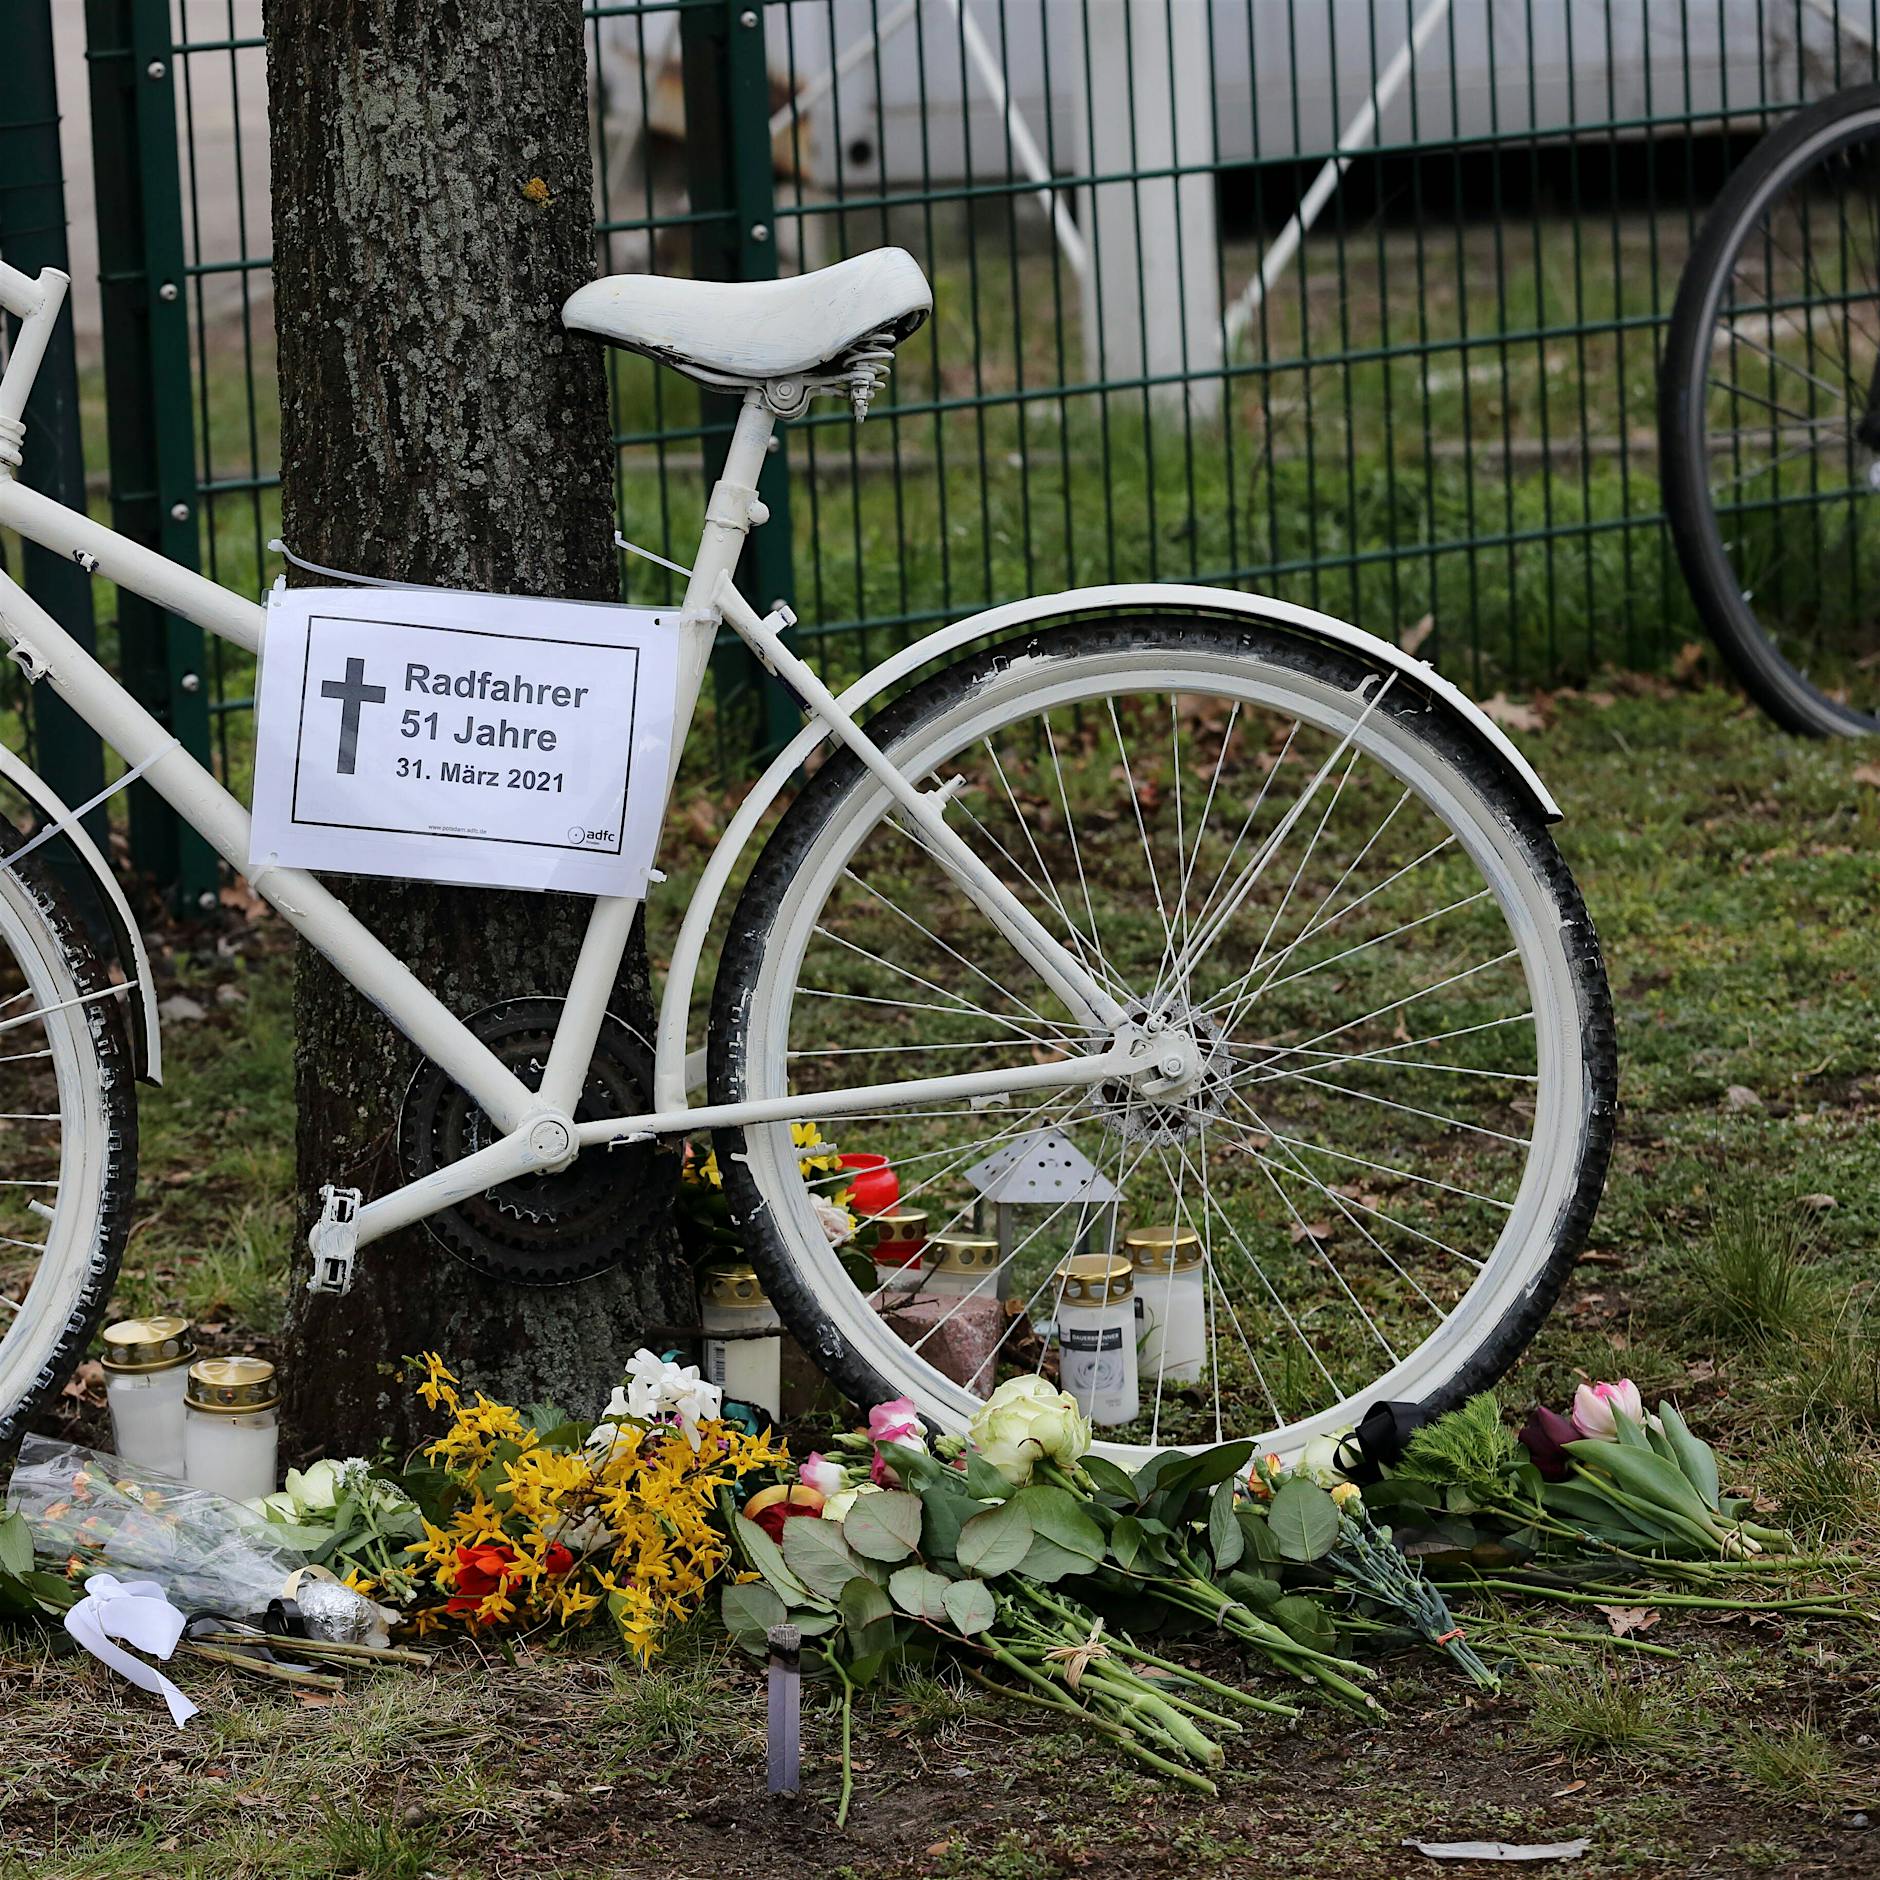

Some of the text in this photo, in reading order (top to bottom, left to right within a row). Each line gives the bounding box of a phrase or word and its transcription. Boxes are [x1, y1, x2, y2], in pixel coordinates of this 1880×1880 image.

[404, 662, 589, 709] Radfahrer
[400, 709, 557, 752] 51 Jahre
[395, 757, 563, 793] 31. März 2021
[586, 829, 615, 842] adfc
[1071, 1332, 1119, 1342] DAUERBRNNER
